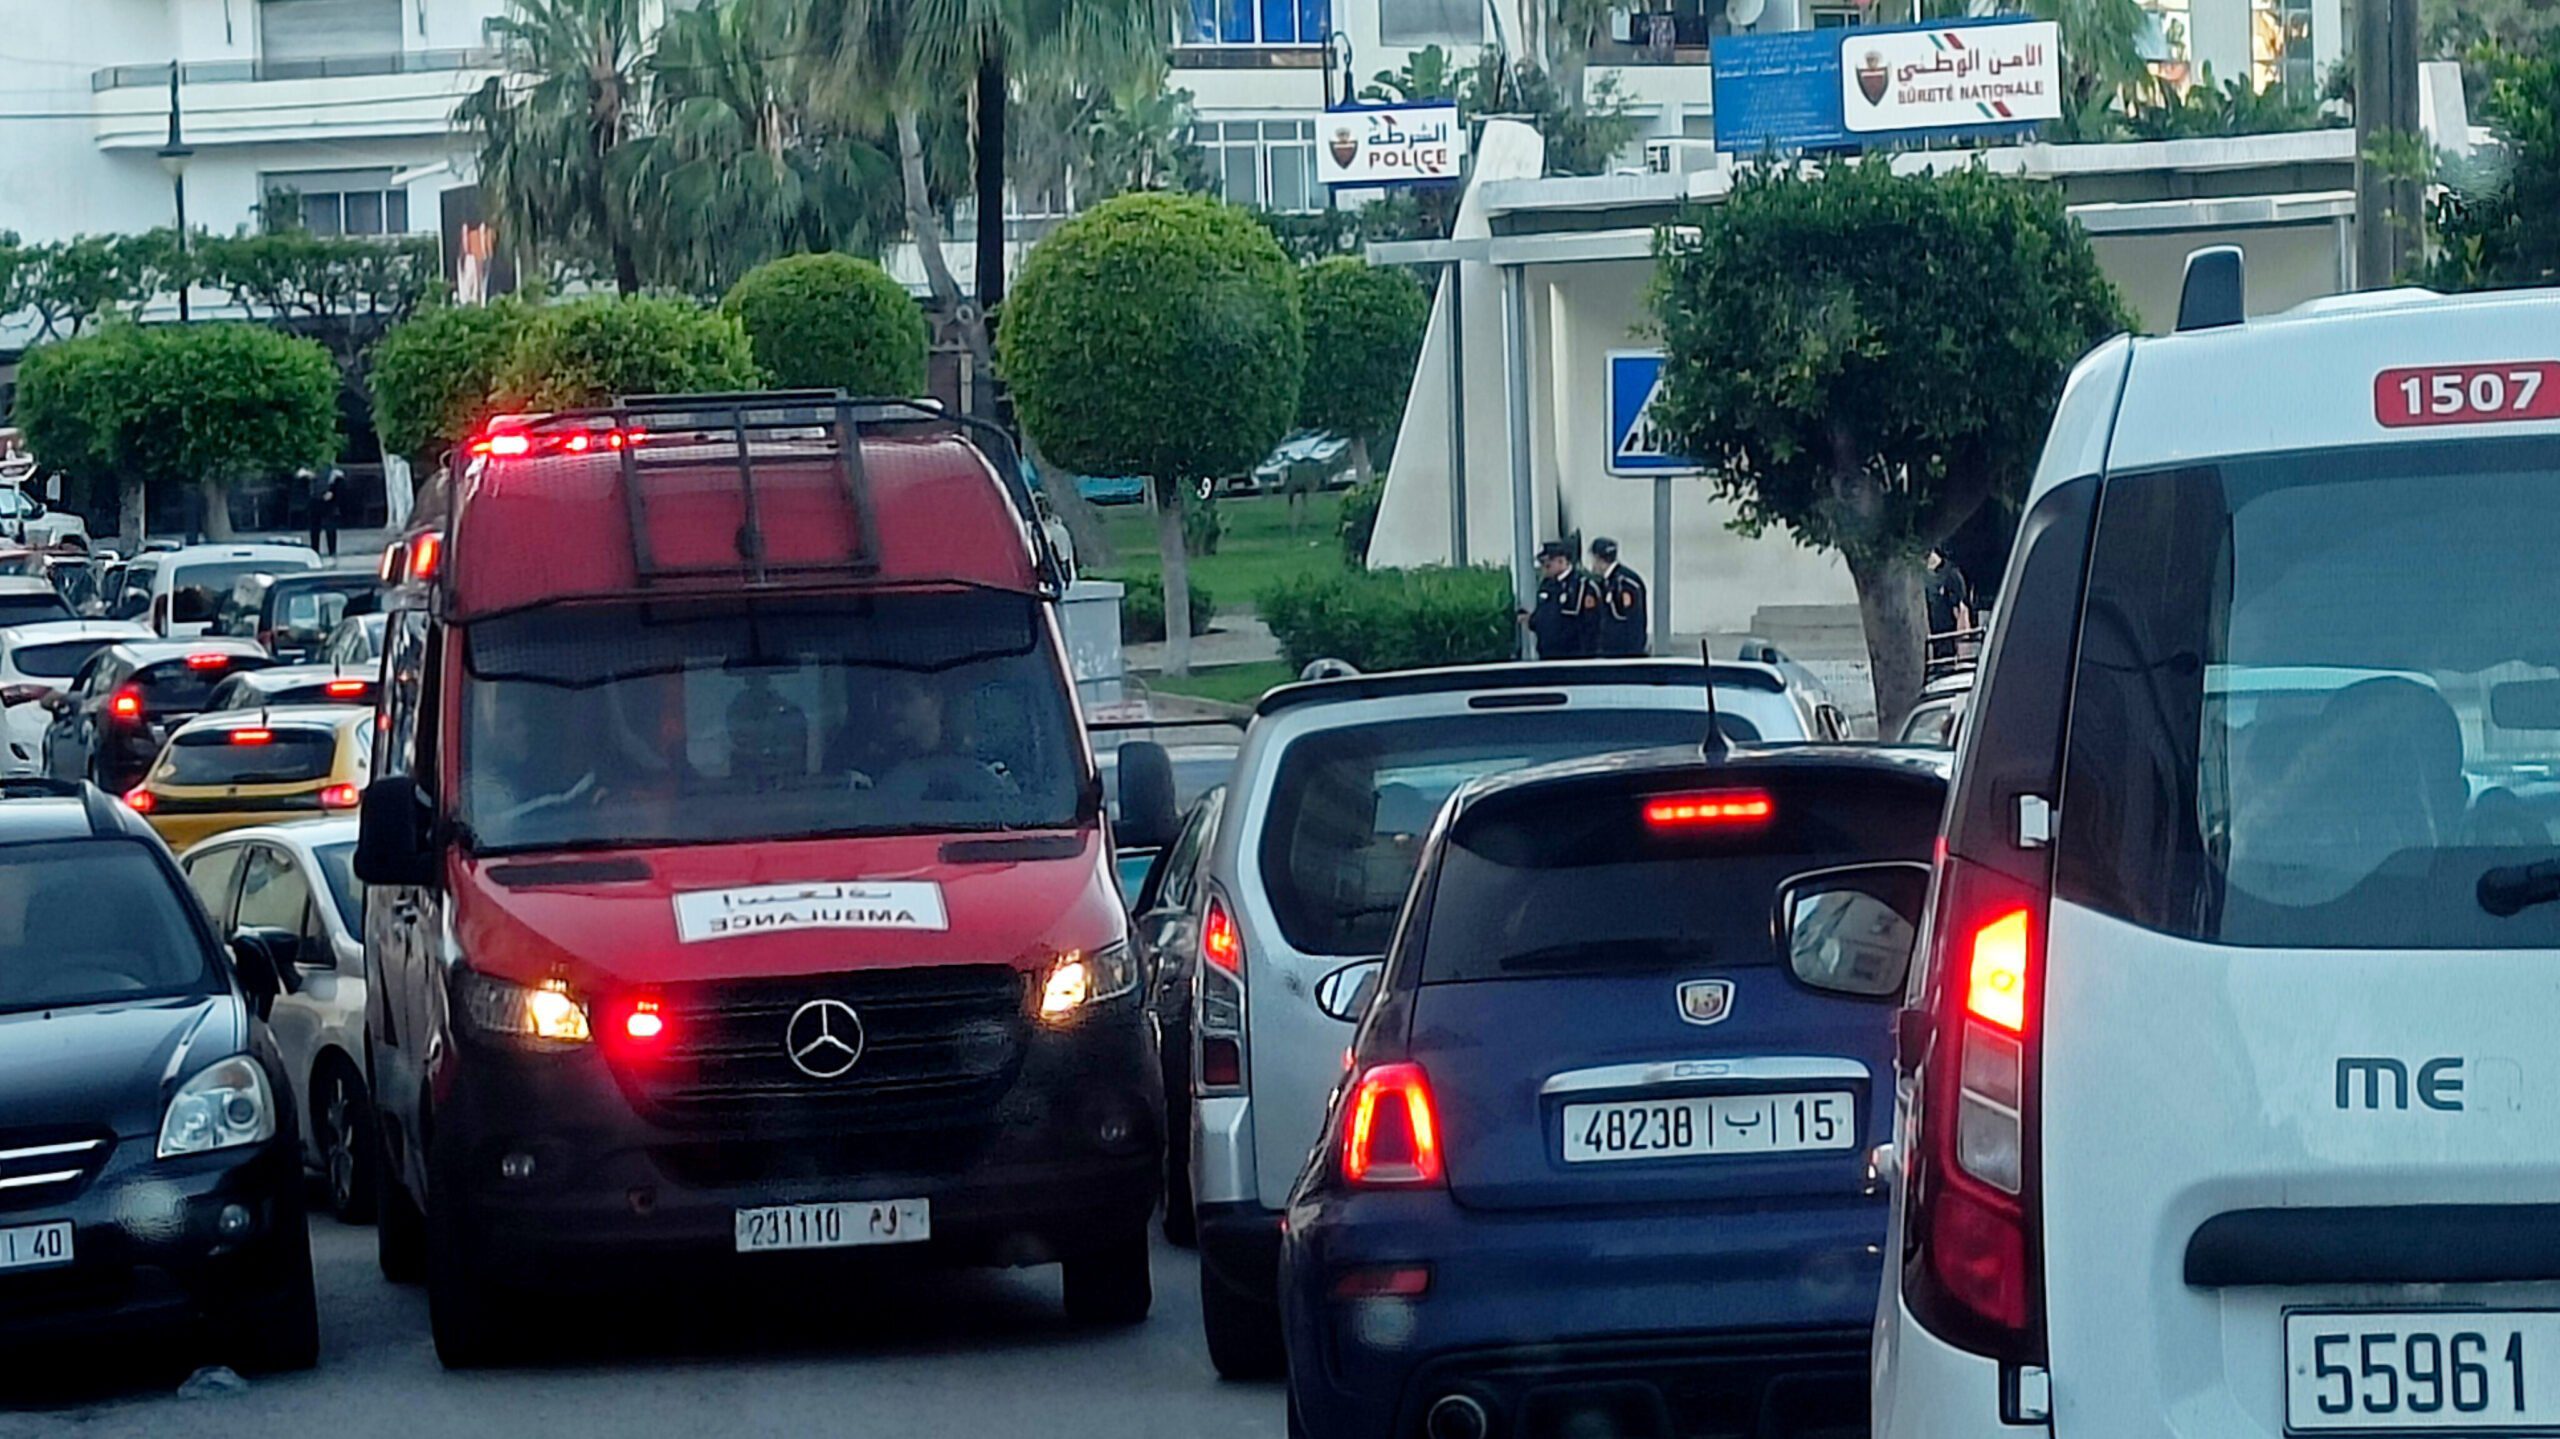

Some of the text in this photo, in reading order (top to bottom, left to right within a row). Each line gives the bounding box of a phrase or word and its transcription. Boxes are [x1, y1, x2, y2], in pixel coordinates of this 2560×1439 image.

[1897, 43, 2043, 86] الأمن الوطني
[1960, 80, 2044, 101] NATIONALE
[1368, 120, 1447, 150] الشرطة
[1368, 148, 1448, 169] POLICE
[2399, 371, 2543, 416] 1507
[1584, 1098, 1836, 1153] 48238 ب 15
[33, 1229, 62, 1259] 40
[749, 1206, 841, 1246] 231110
[2313, 1331, 2526, 1414] 55961
